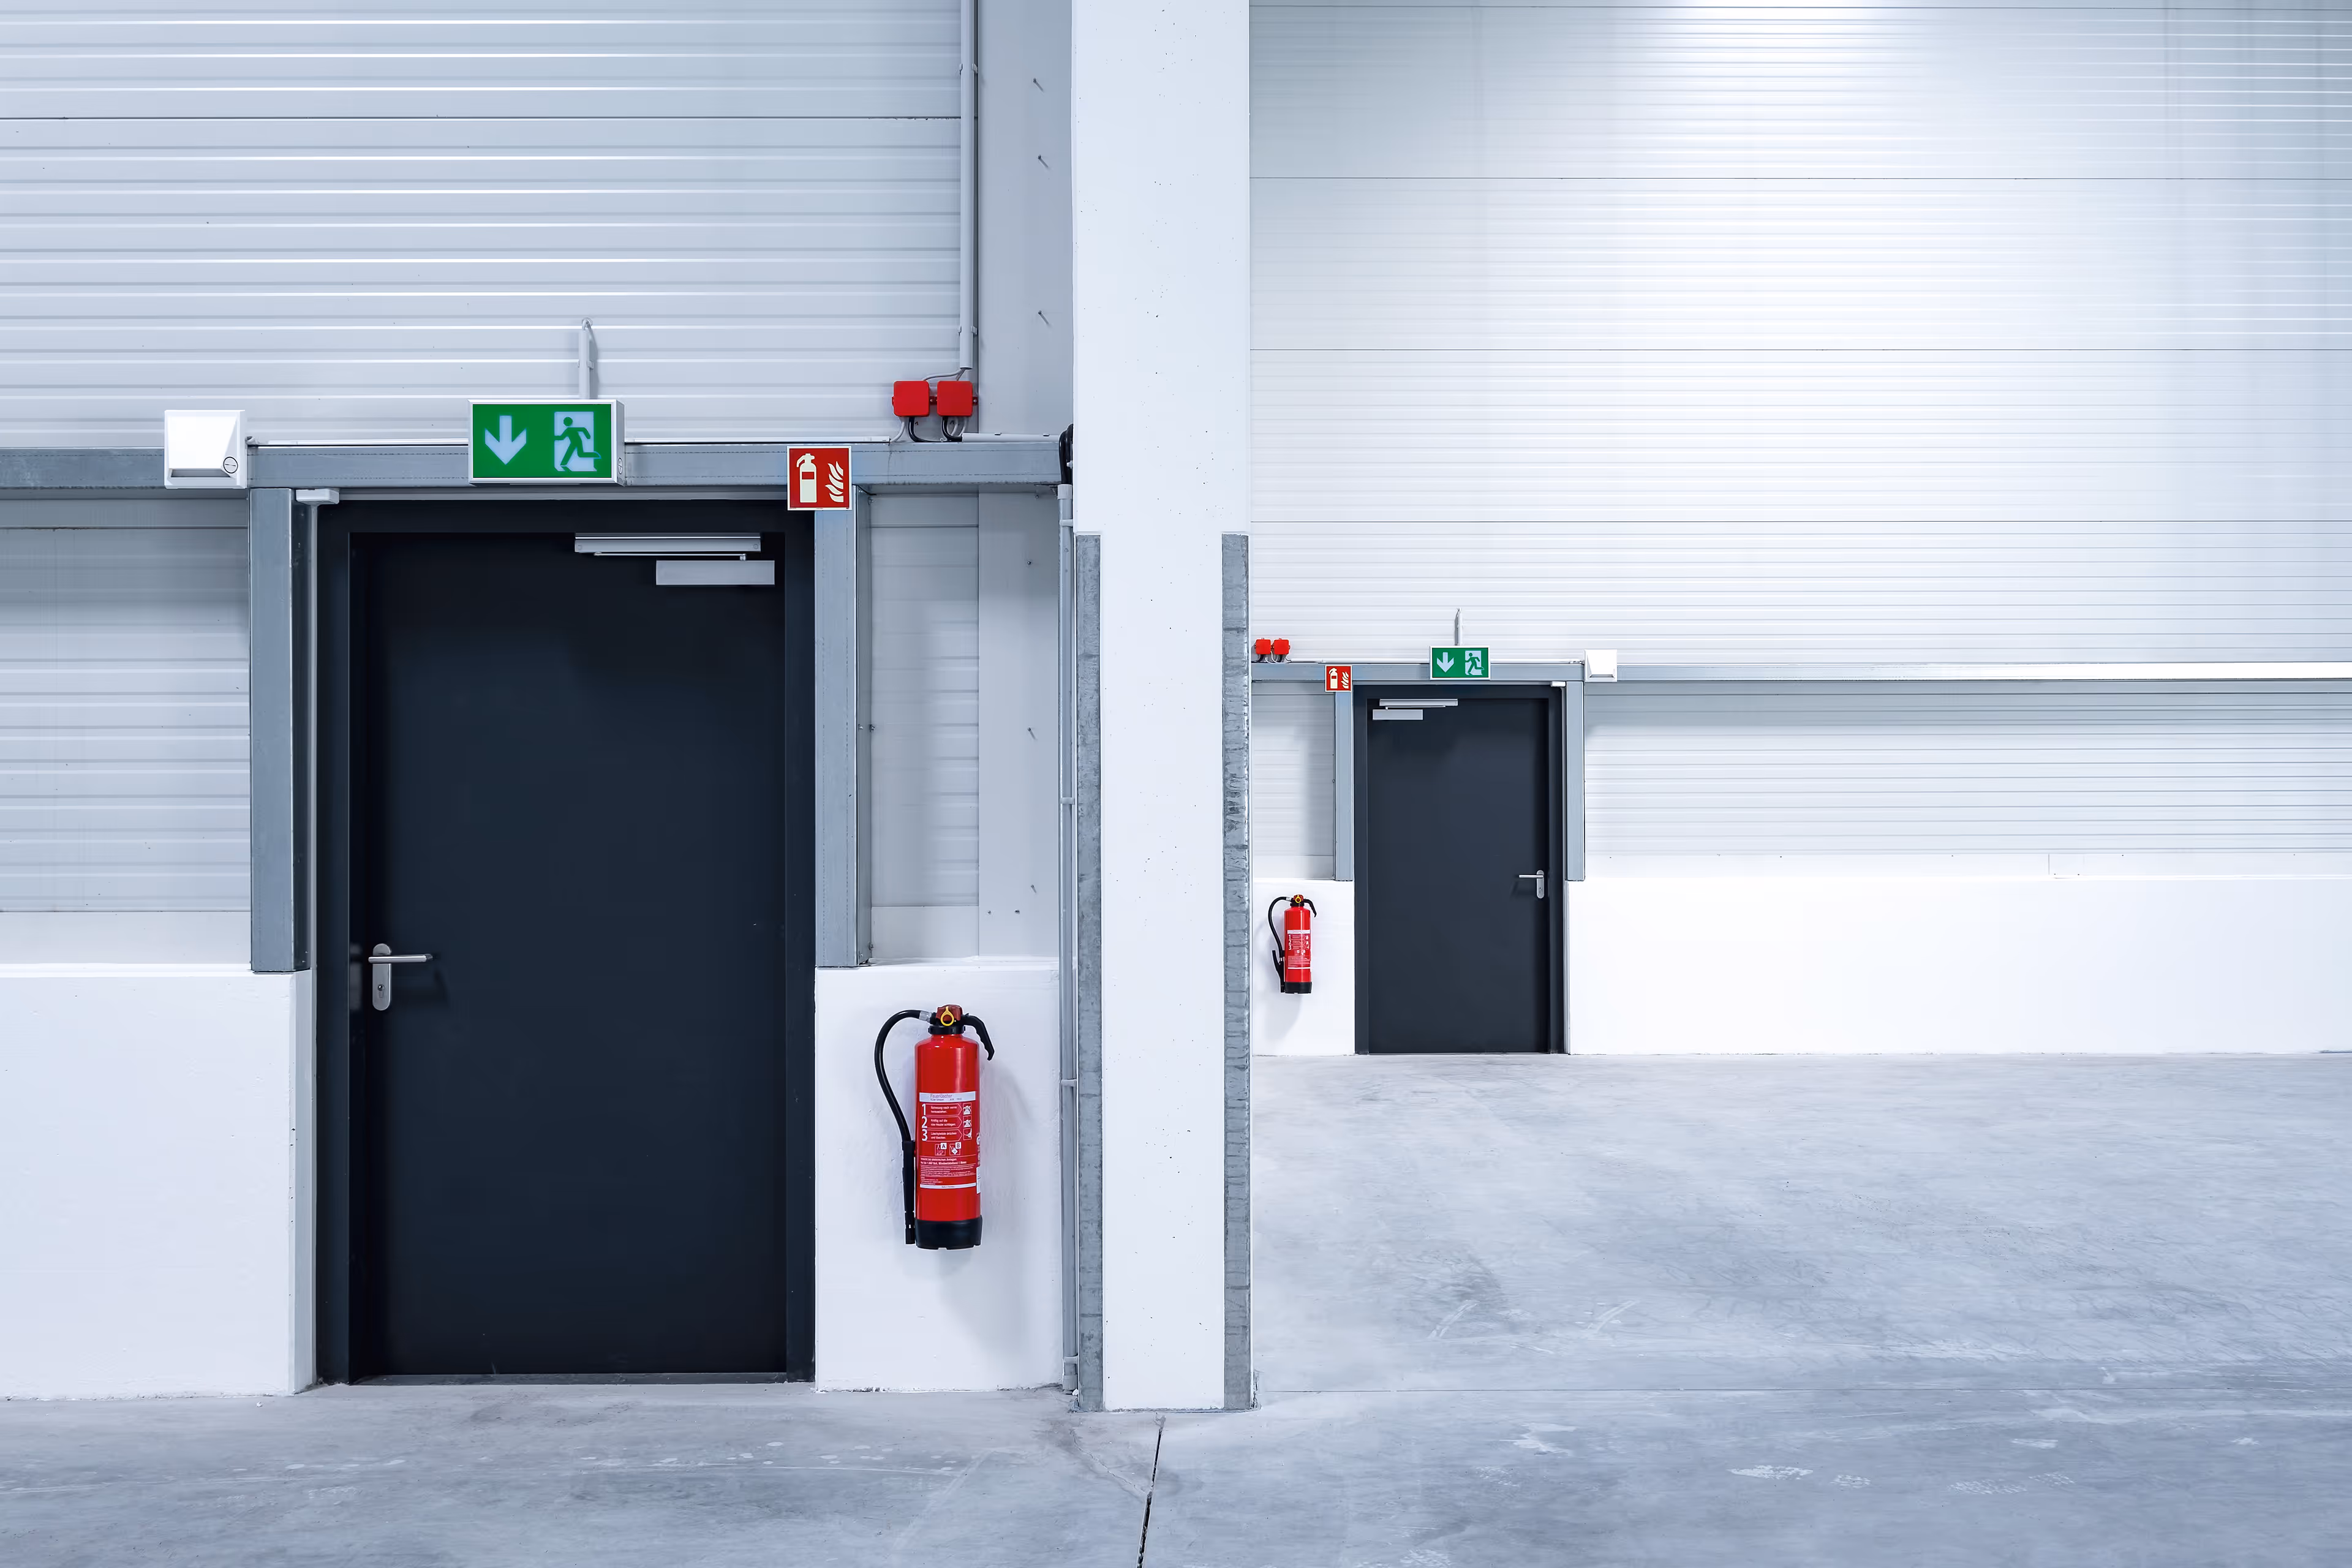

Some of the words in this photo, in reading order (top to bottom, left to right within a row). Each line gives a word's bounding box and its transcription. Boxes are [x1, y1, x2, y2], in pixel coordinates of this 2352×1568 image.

[922, 1104, 925, 1116] 1
[921, 1116, 927, 1128] 2
[922, 1129, 927, 1141] 3
